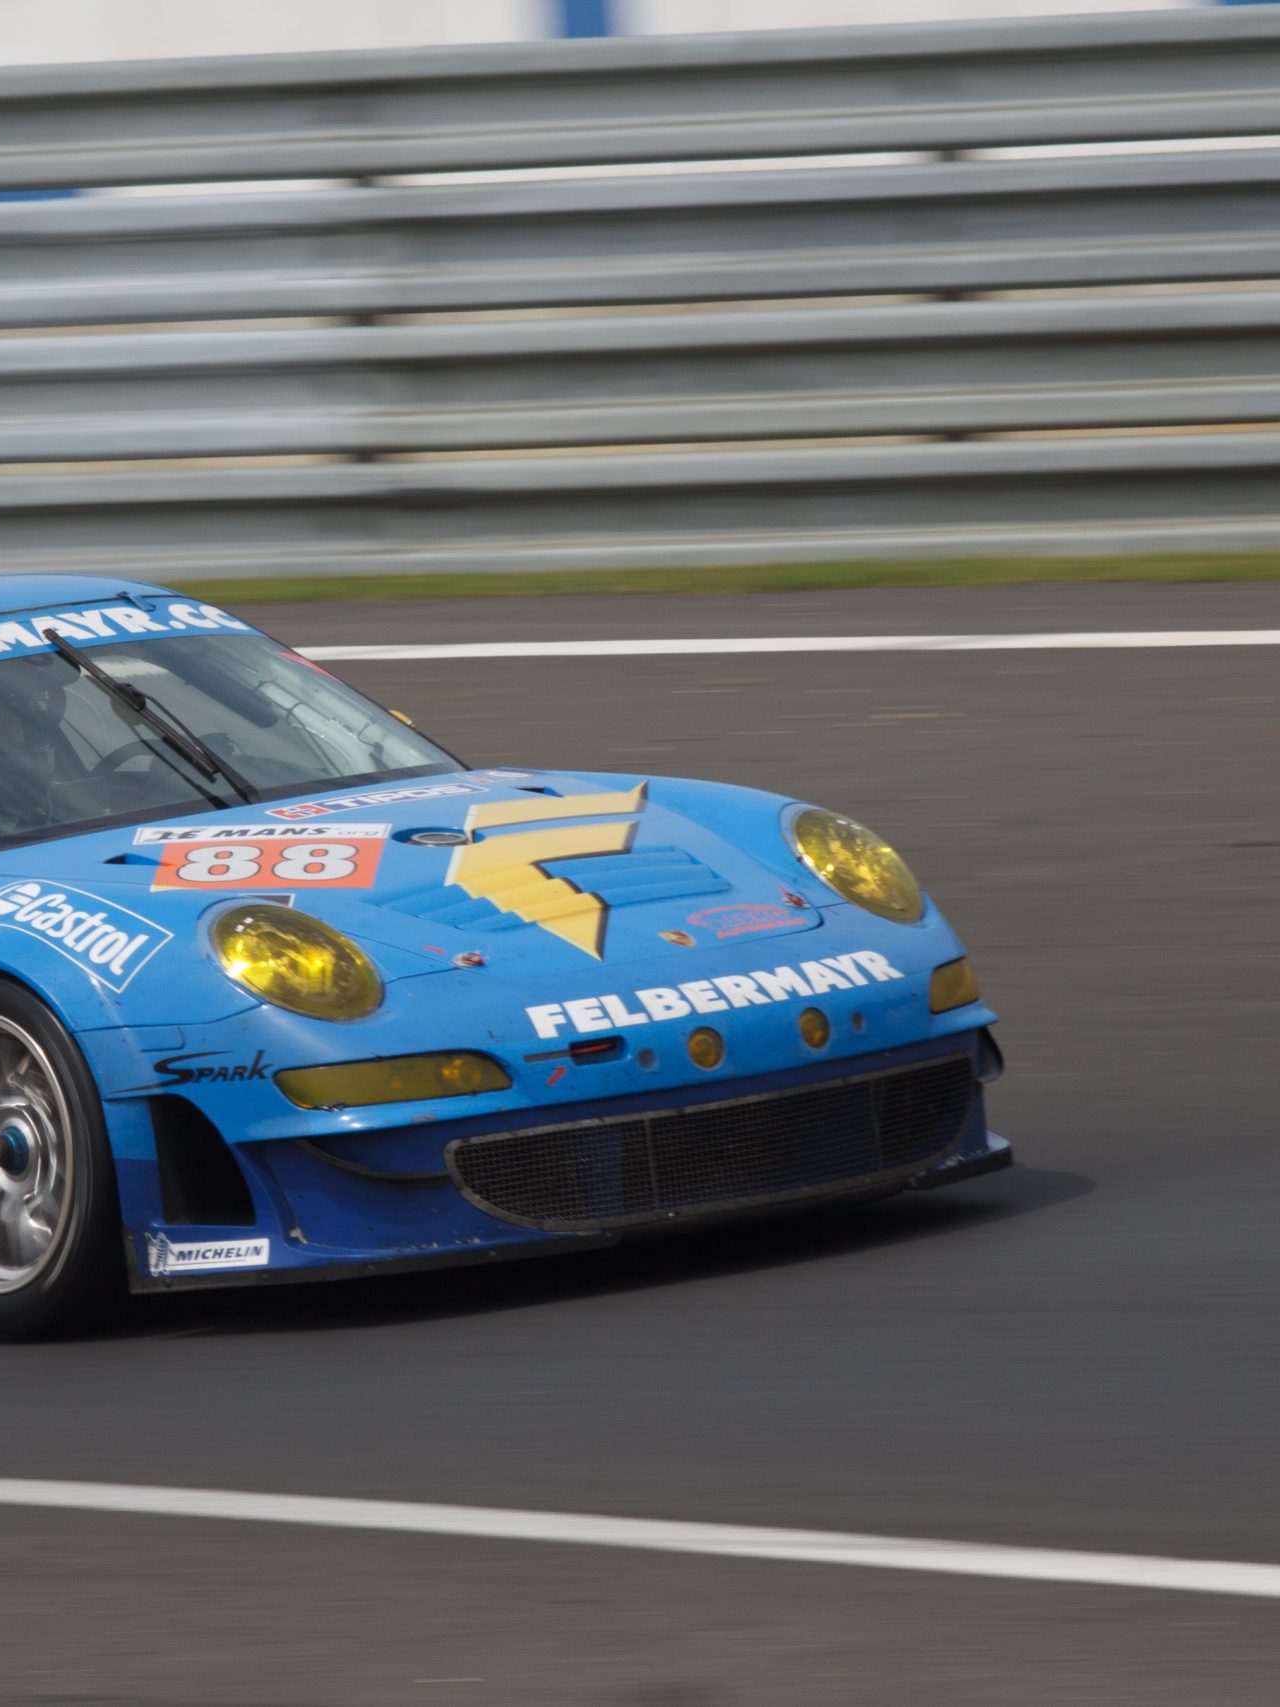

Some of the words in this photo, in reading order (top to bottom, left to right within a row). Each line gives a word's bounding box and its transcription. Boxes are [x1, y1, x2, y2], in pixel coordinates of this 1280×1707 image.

[211, 827, 331, 838] MANS
[176, 843, 359, 882] 88
[14, 893, 150, 976] Castrol
[524, 950, 906, 1040] FELBERMAYR
[176, 1245, 264, 1262] MICHELIN
